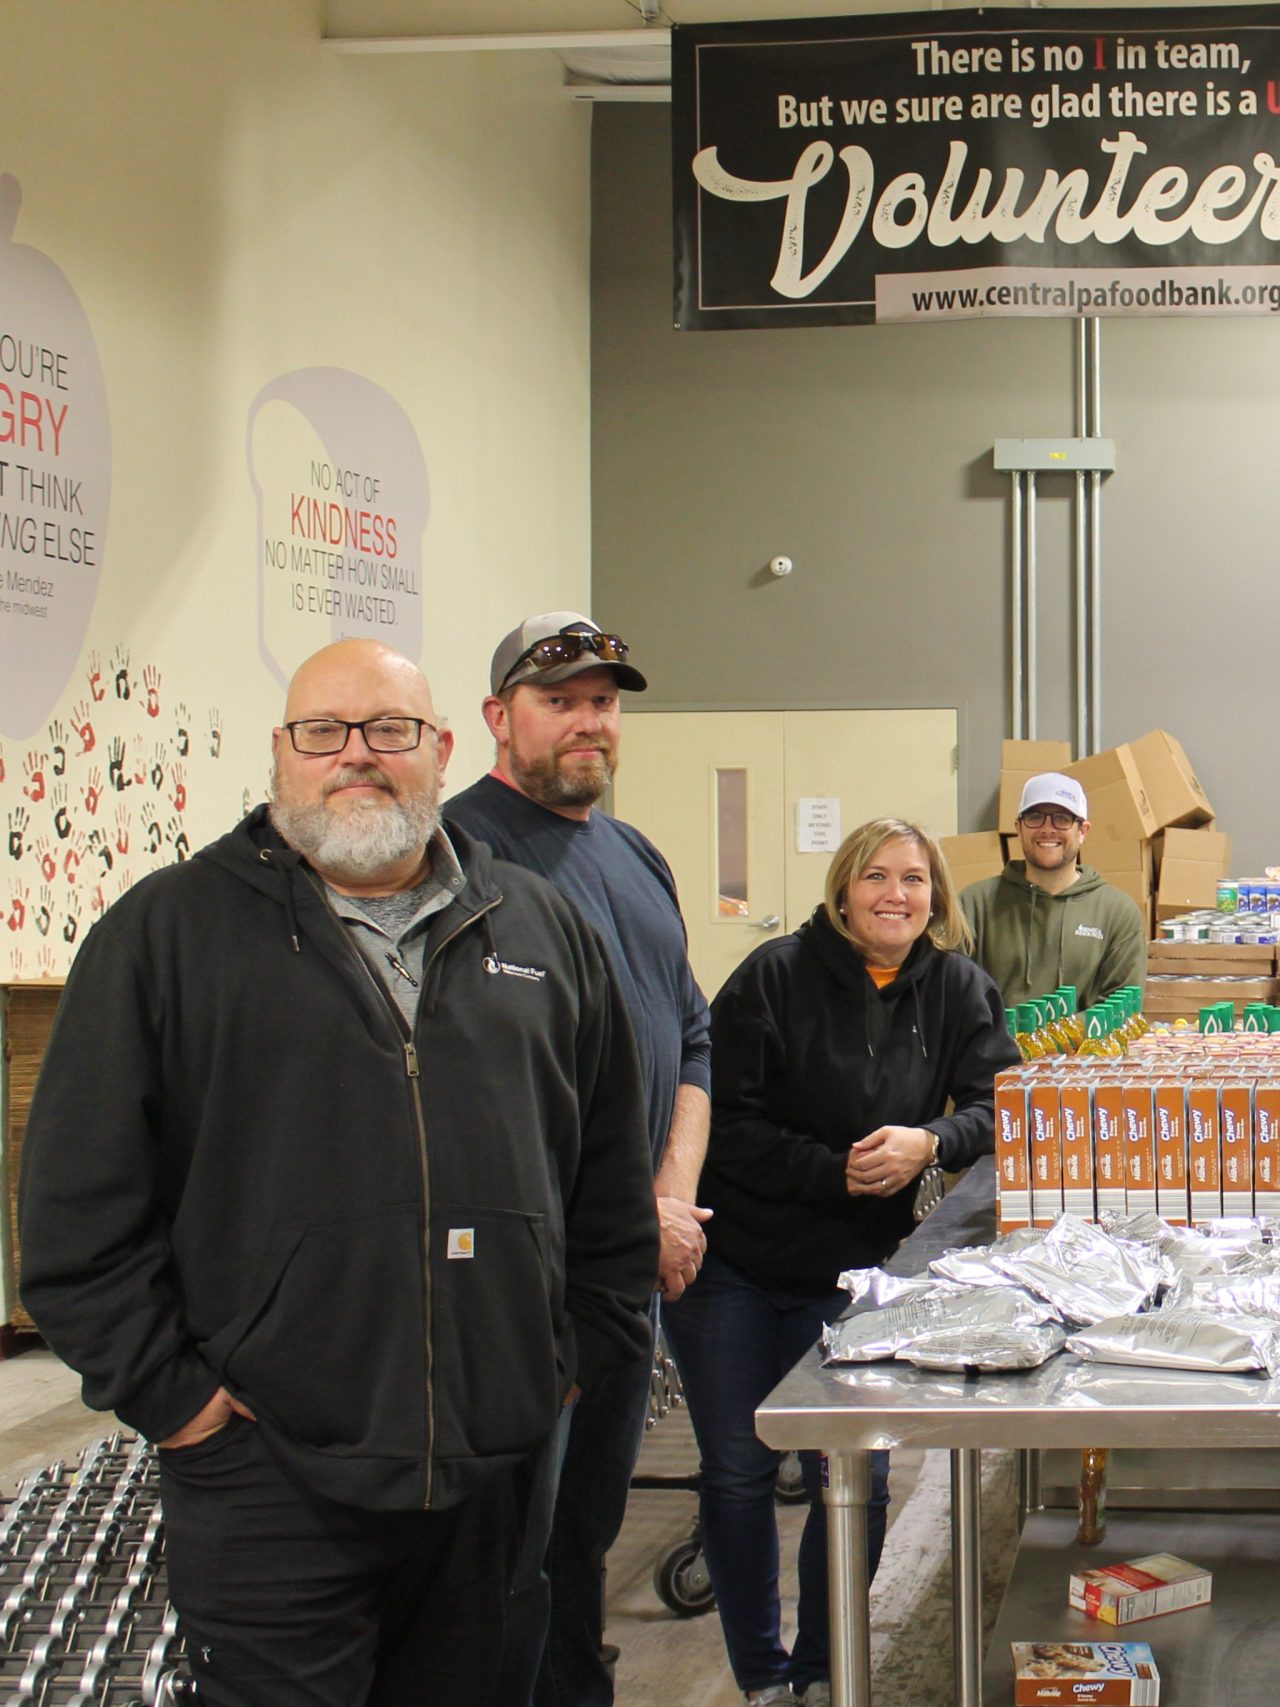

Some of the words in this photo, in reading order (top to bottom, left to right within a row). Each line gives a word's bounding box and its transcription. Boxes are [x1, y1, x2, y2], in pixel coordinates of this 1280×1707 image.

[911, 41, 1002, 75] There
[1011, 38, 1035, 73] is
[1044, 45, 1083, 71] no
[1095, 38, 1107, 70] I
[1116, 38, 1146, 70] in
[1155, 40, 1250, 74] team,
[778, 95, 833, 128] But
[841, 99, 887, 125] we
[896, 95, 963, 123] sure
[970, 92, 1021, 118] are
[1031, 83, 1100, 128] glad
[1109, 82, 1197, 117] there
[1206, 82, 1231, 116] is
[1239, 90, 1257, 115] a
[16, 465, 83, 516] THINK
[311, 460, 332, 491] NO
[335, 468, 360, 498] ACT
[363, 476, 380, 503] OF
[0, 511, 37, 554] NG
[44, 522, 95, 566] ELSE
[291, 492, 398, 559] KINDNESS
[7, 569, 54, 598] Mendez
[265, 539, 287, 570] NO
[291, 545, 345, 582] MATTER
[347, 556, 378, 586] HOW
[381, 564, 418, 595] SMALL
[292, 583, 304, 611] IS
[308, 585, 342, 617] EVER
[345, 592, 399, 626] WASTED.
[1001, 1109, 1011, 1142] Chewy
[1034, 1108, 1045, 1141] Chewy
[1064, 1108, 1076, 1141] Chewy
[1098, 1108, 1109, 1141] Chewy
[1127, 1108, 1138, 1141] Chewy
[1159, 1108, 1170, 1141] Chewy
[1193, 1110, 1203, 1143] Chewy
[1225, 1110, 1235, 1143] Chewy
[1259, 1110, 1269, 1143] Chewy
[1098, 1644, 1136, 1677] Chewy
[1072, 1682, 1105, 1693] Chewy
